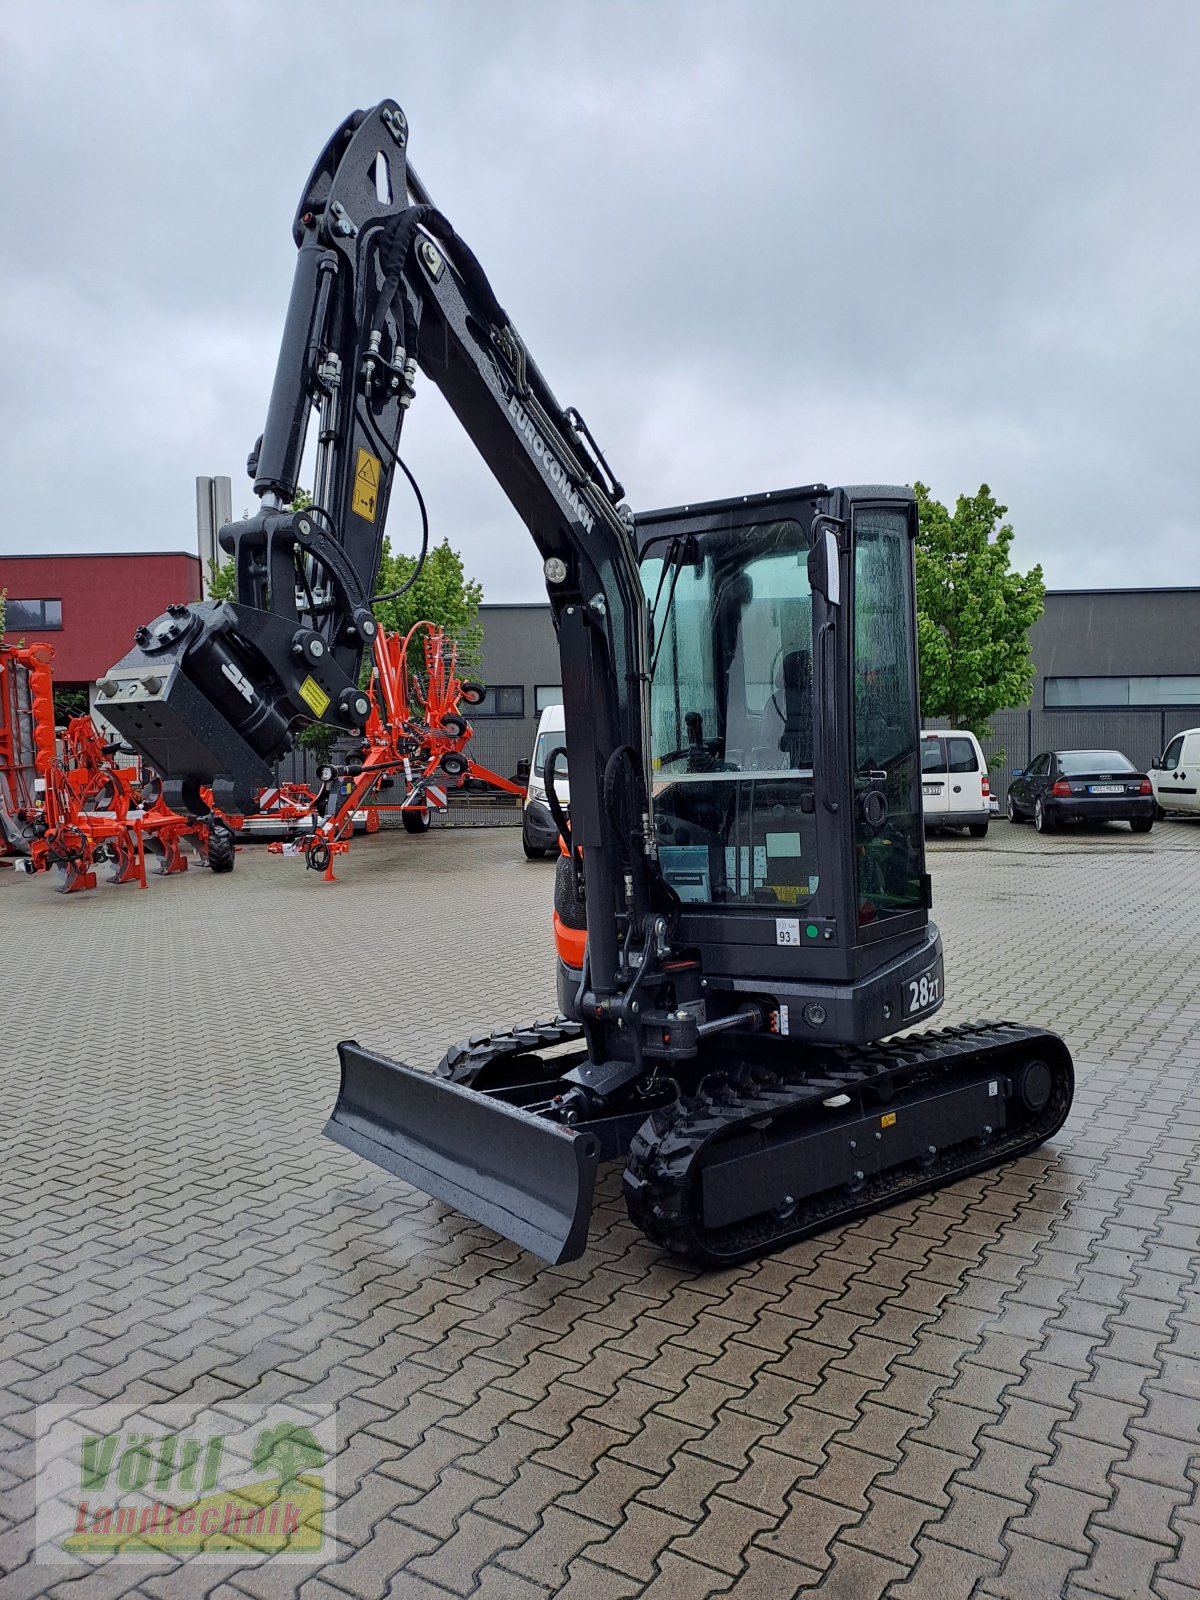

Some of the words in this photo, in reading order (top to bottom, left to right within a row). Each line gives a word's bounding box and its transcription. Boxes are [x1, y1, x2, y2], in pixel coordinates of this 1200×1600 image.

[507, 394, 595, 535] EUROCOMACH
[779, 931, 791, 943] 93
[909, 978, 939, 1012] 28ZT
